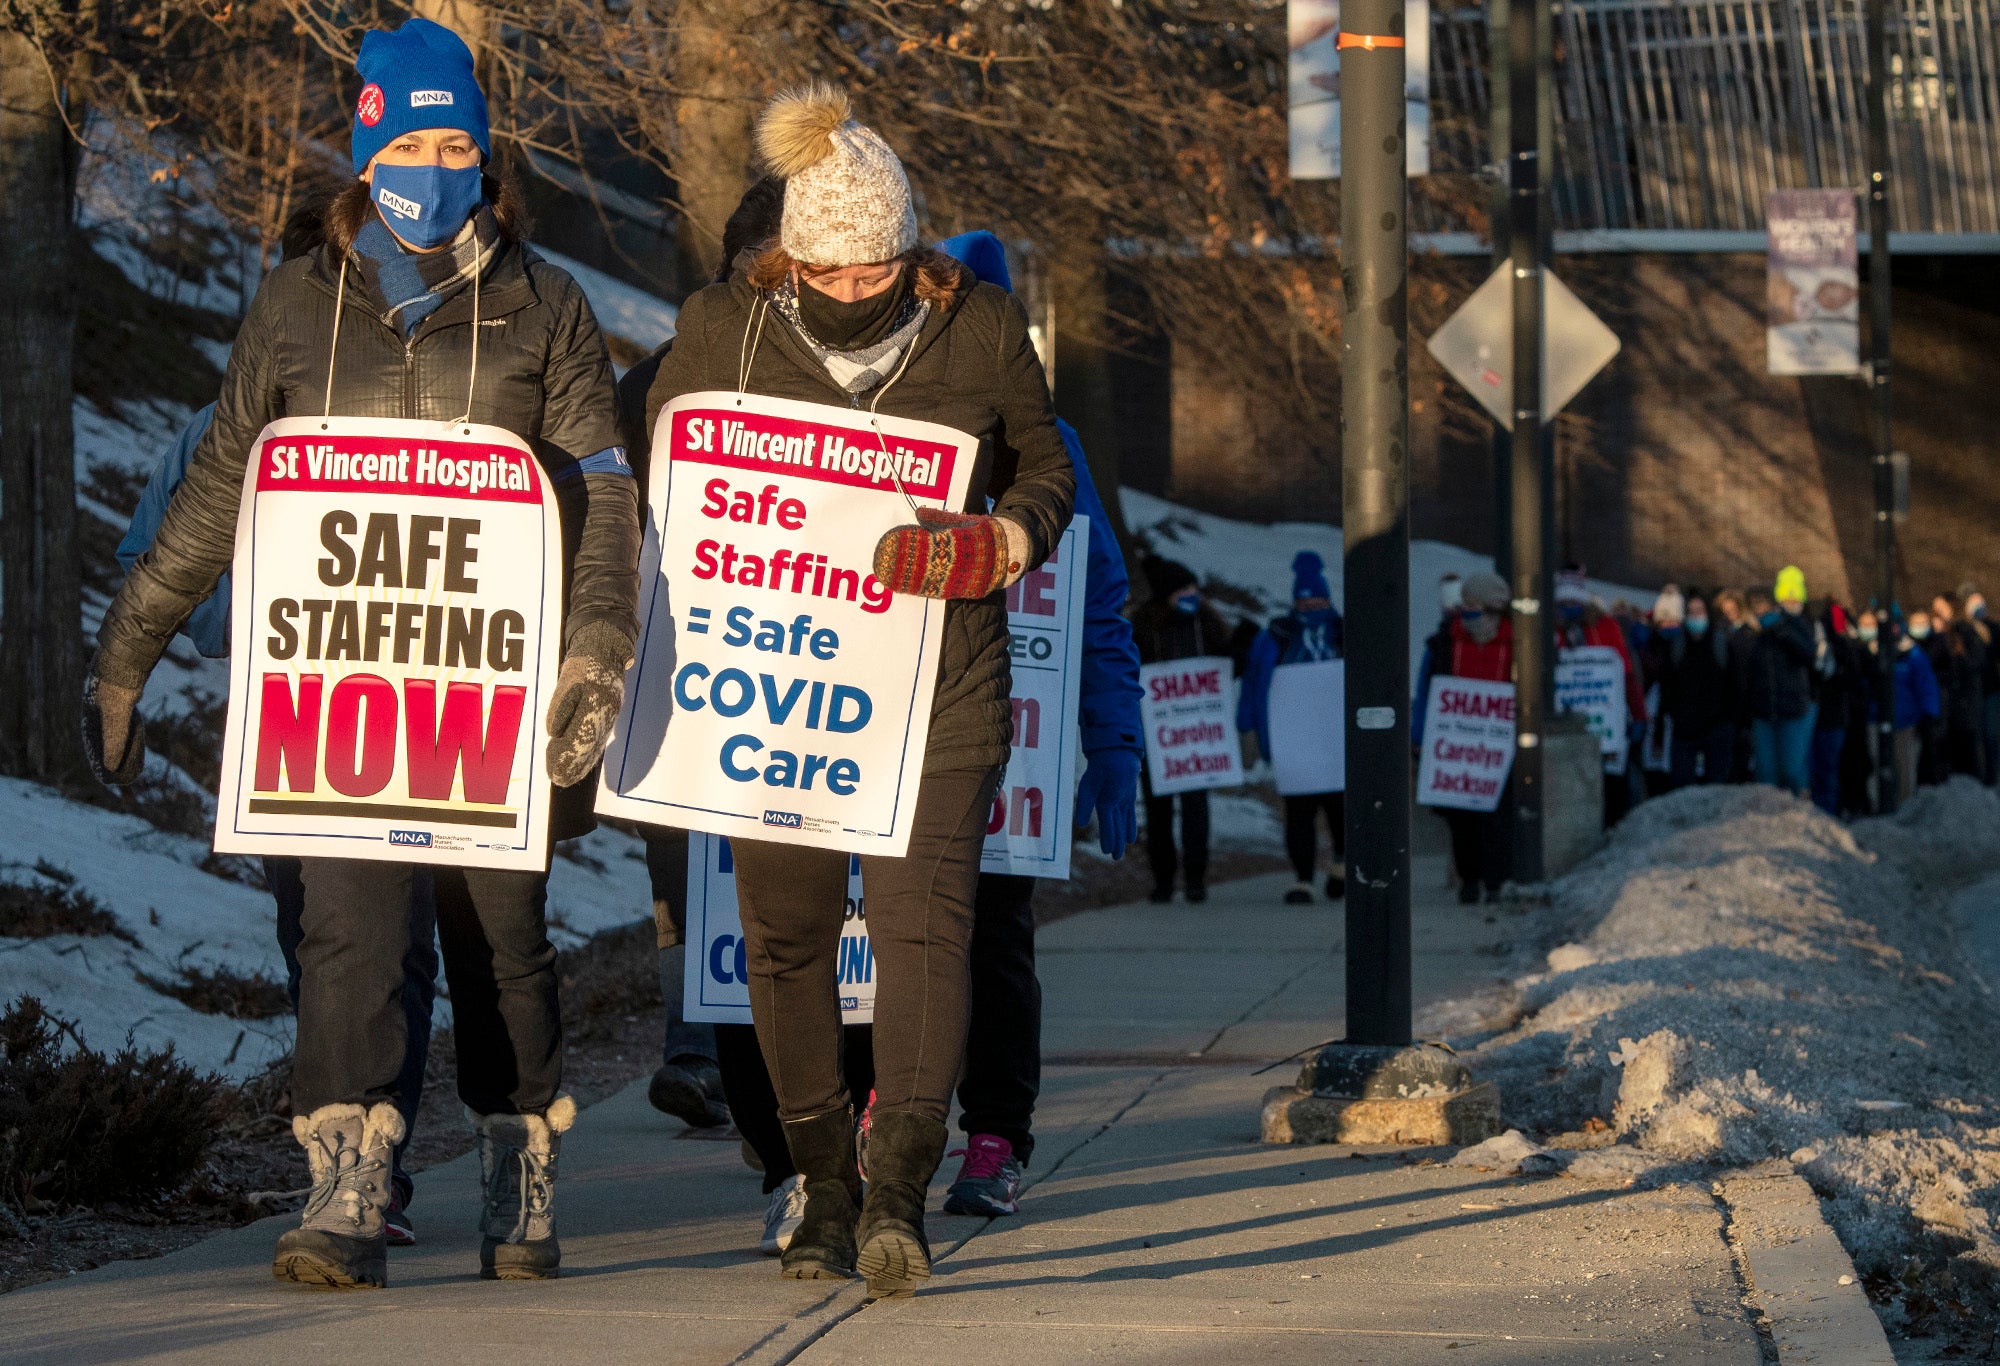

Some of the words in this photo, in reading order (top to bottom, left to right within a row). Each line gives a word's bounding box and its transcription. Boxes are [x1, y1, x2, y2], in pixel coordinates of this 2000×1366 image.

[413, 93, 450, 103] MNA
[382, 192, 416, 216] MNA
[270, 445, 300, 479] St
[305, 445, 410, 484] Vincent
[416, 448, 531, 494] Hospital
[686, 417, 715, 453] St
[722, 419, 816, 467] Vincent
[820, 435, 942, 487] Hospital
[700, 477, 807, 531] Safe
[317, 509, 482, 594] SAFE
[691, 538, 894, 614] Staffing
[267, 597, 526, 672] STAFFING
[722, 605, 840, 661] Safe
[1008, 633, 1053, 661] EO
[674, 661, 873, 734] COVID
[1150, 668, 1221, 702] SHAME
[1439, 689, 1516, 722] SHAME
[253, 672, 528, 805] NOW
[719, 733, 861, 796] Care
[390, 831, 427, 844] MNA
[764, 812, 797, 825] MNA
